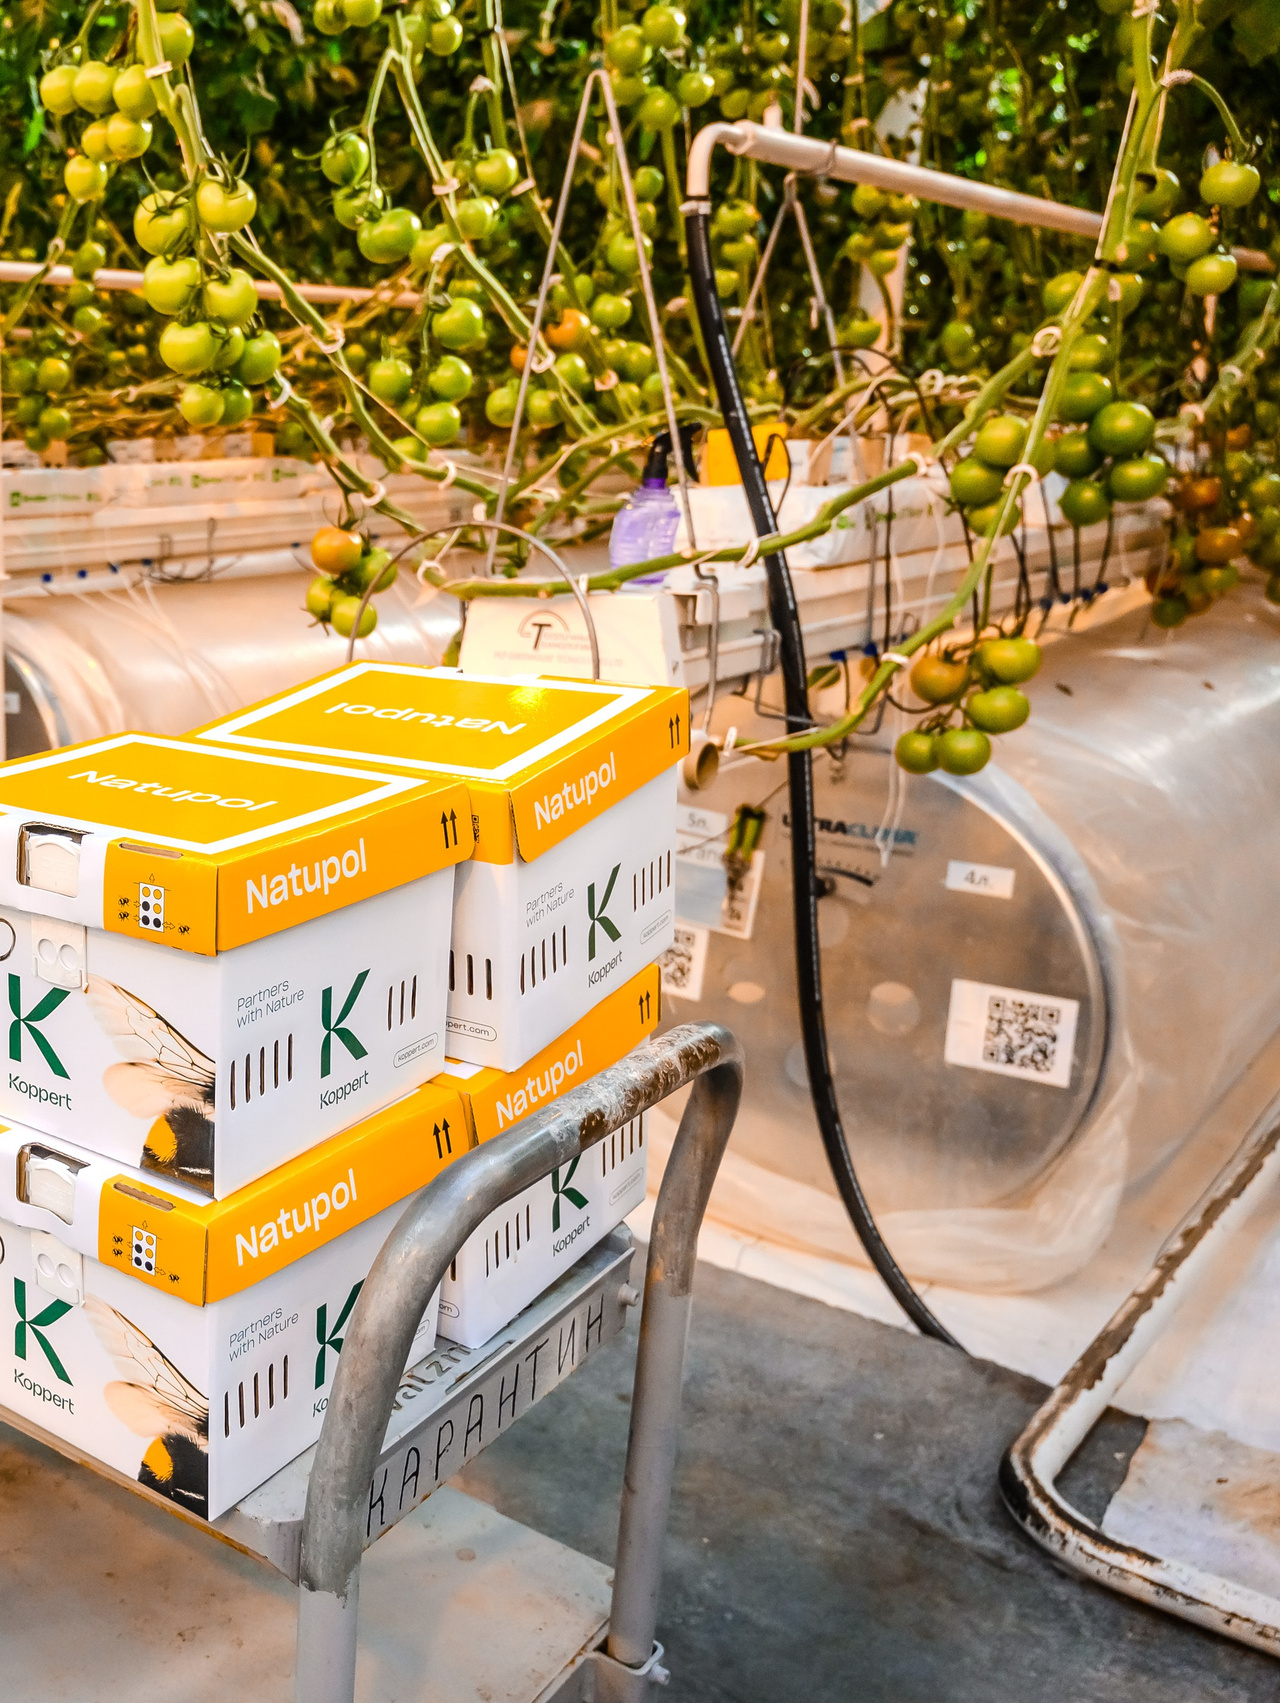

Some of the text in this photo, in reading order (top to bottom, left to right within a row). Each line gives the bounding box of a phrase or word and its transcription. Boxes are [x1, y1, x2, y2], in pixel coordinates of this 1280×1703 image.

[324, 701, 528, 736] Natupol
[69, 769, 278, 811] Natupol
[533, 751, 618, 830] Natupol
[245, 836, 368, 914] Natupol
[525, 881, 564, 915] Partners
[525, 887, 576, 929] with Nature
[587, 949, 624, 989] Koppert
[236, 979, 291, 1013] Partners
[236, 987, 306, 1029] with Nature
[445, 1020, 490, 1037] pert.com
[8, 1072, 73, 1112] Koppert
[319, 1069, 370, 1110] Koppert
[496, 1039, 585, 1129] Natupol
[234, 1167, 358, 1267] Natupol
[551, 1215, 591, 1257] Koppert
[228, 1307, 284, 1347] Partners
[228, 1311, 300, 1362] with Nature
[13, 1368, 75, 1415] Koppert
[365, 1293, 606, 1538] КАРАНТИН
